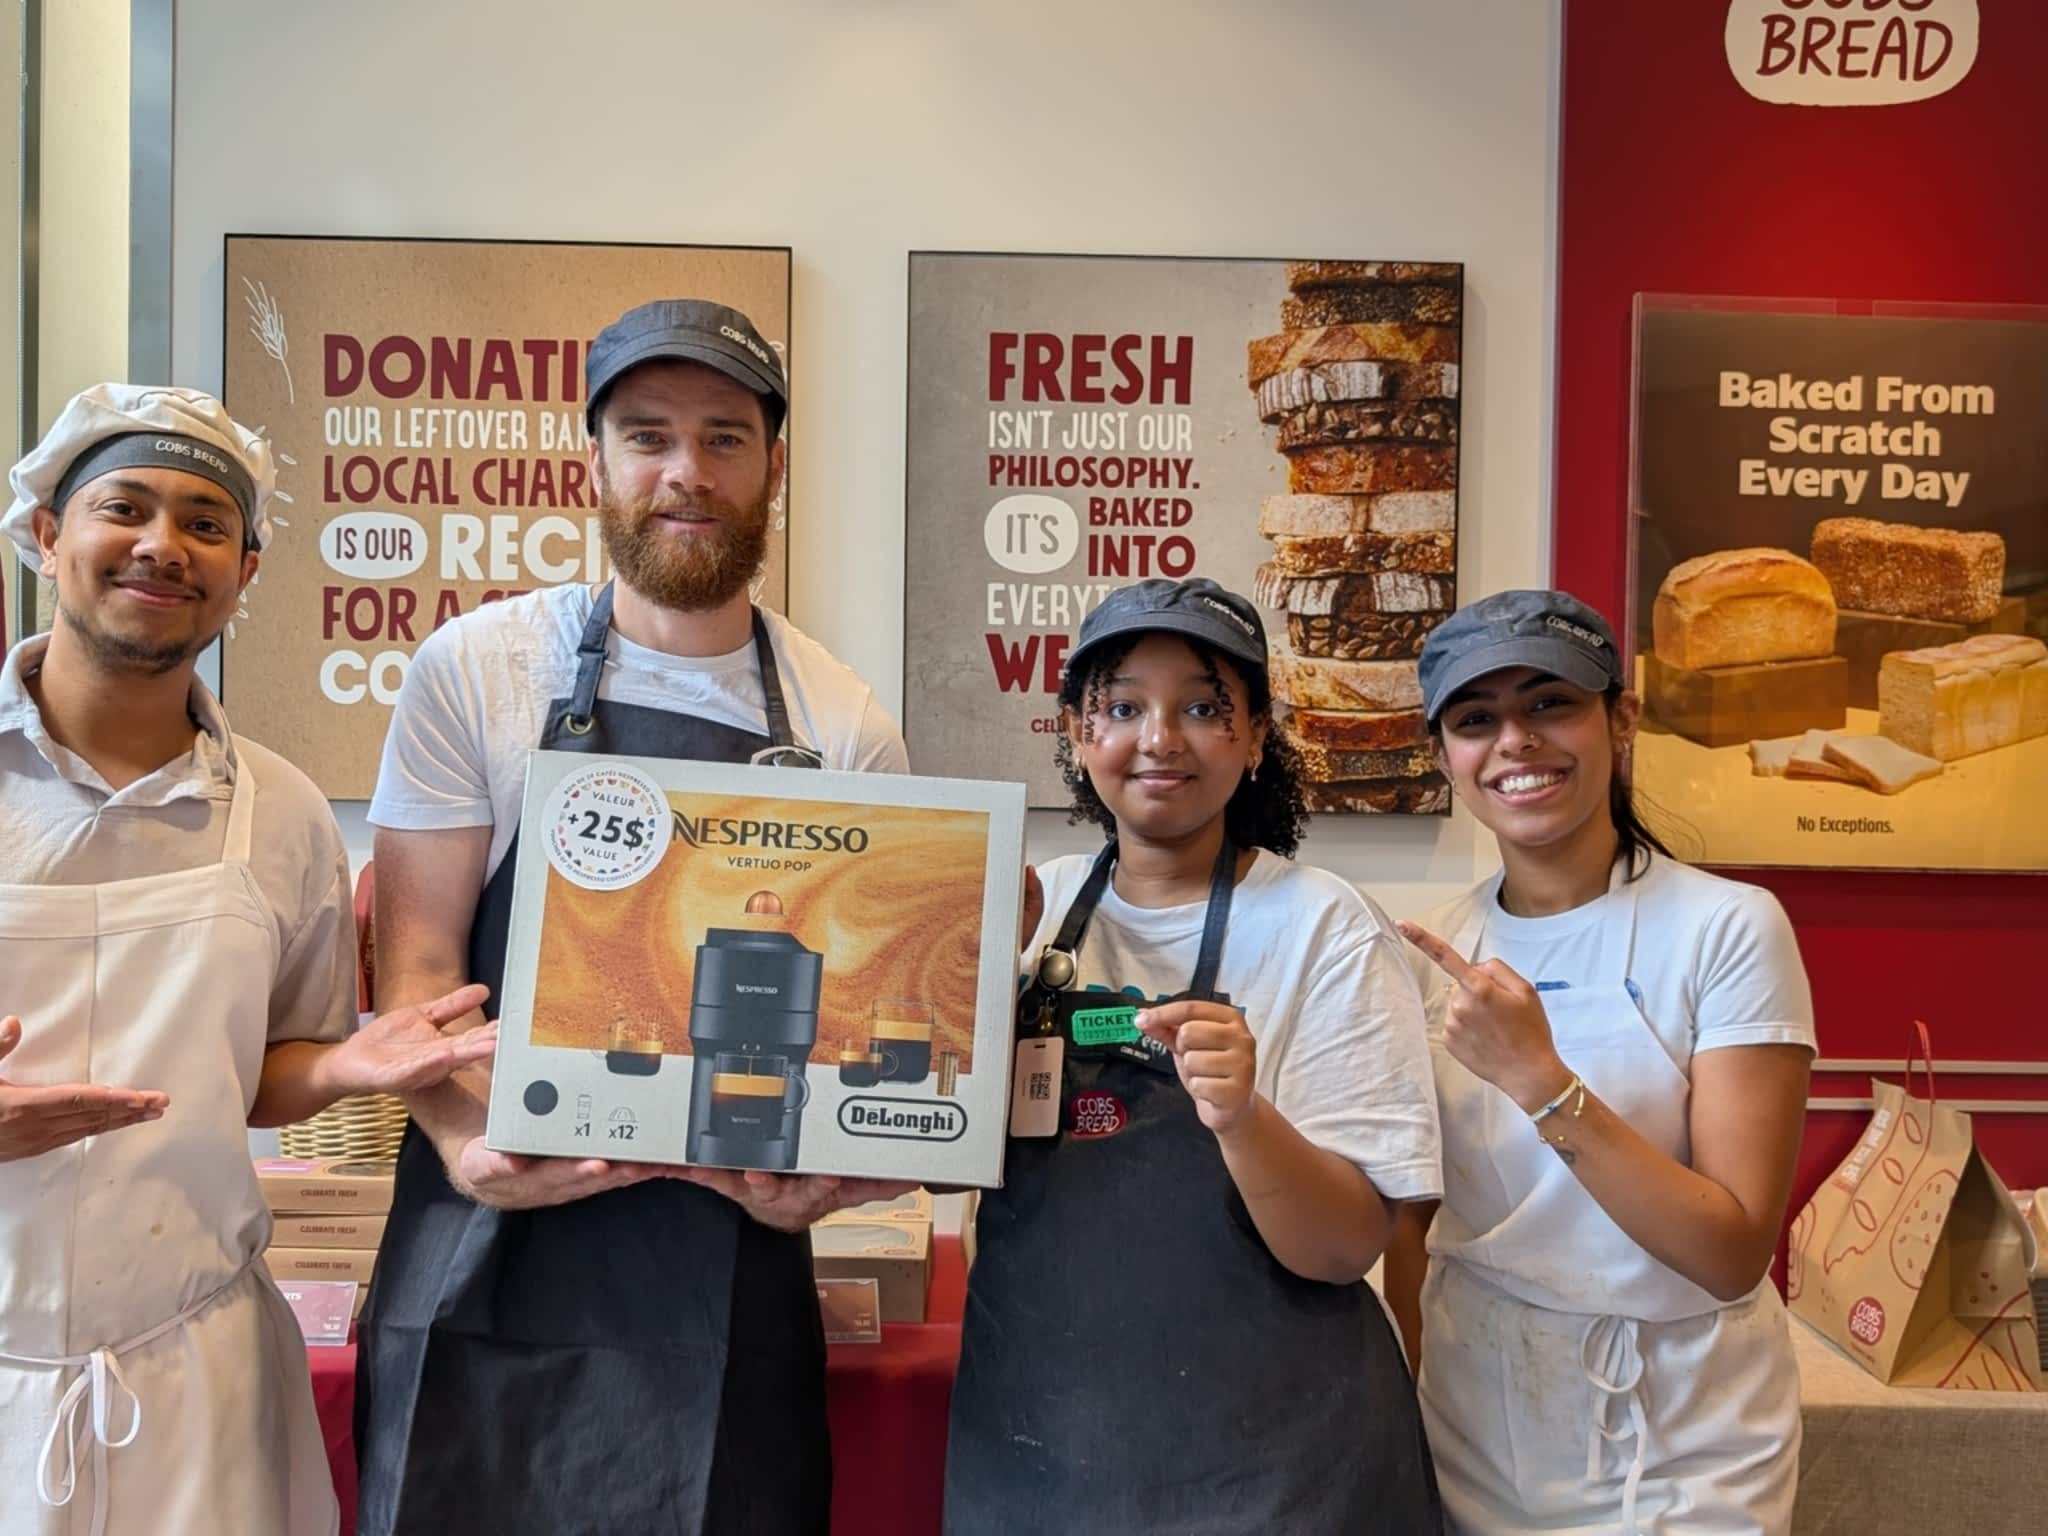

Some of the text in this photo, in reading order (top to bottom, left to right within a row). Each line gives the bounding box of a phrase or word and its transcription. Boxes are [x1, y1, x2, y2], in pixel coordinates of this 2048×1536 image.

[1756, 13, 1953, 82] BREAD
[323, 334, 594, 402] DONATI
[988, 332, 1194, 405] FRESH
[1719, 371, 1994, 415] Baked From
[155, 439, 191, 456] COBS
[324, 406, 382, 448] OUR
[393, 408, 529, 450] LEFTOVER
[988, 410, 1193, 452] ISN'T JUST OUR
[1768, 416, 1941, 456] Scratch
[323, 455, 458, 506] LOCAL
[988, 454, 1200, 489] PHILOSOPHY.
[1739, 459, 1970, 507] Every Day
[1089, 497, 1193, 528] BAKED
[336, 527, 413, 561] IS OUR
[440, 513, 604, 583] RECI
[1005, 513, 1060, 555] IT'S
[1088, 534, 1196, 578] INTO
[322, 586, 461, 642] FOR A
[319, 650, 412, 705] CO
[593, 791, 635, 808] VALEUR
[671, 809, 869, 853] NESPRESSO
[1797, 816, 1894, 835] No Exceptions.
[583, 846, 618, 861] VALUE
[728, 856, 812, 872] VERTUO POP
[1079, 1014, 1134, 1027] TICKET
[1075, 1115, 1120, 1133] BREAD
[1077, 1096, 1116, 1115] COBS
[574, 1122, 590, 1136] x1
